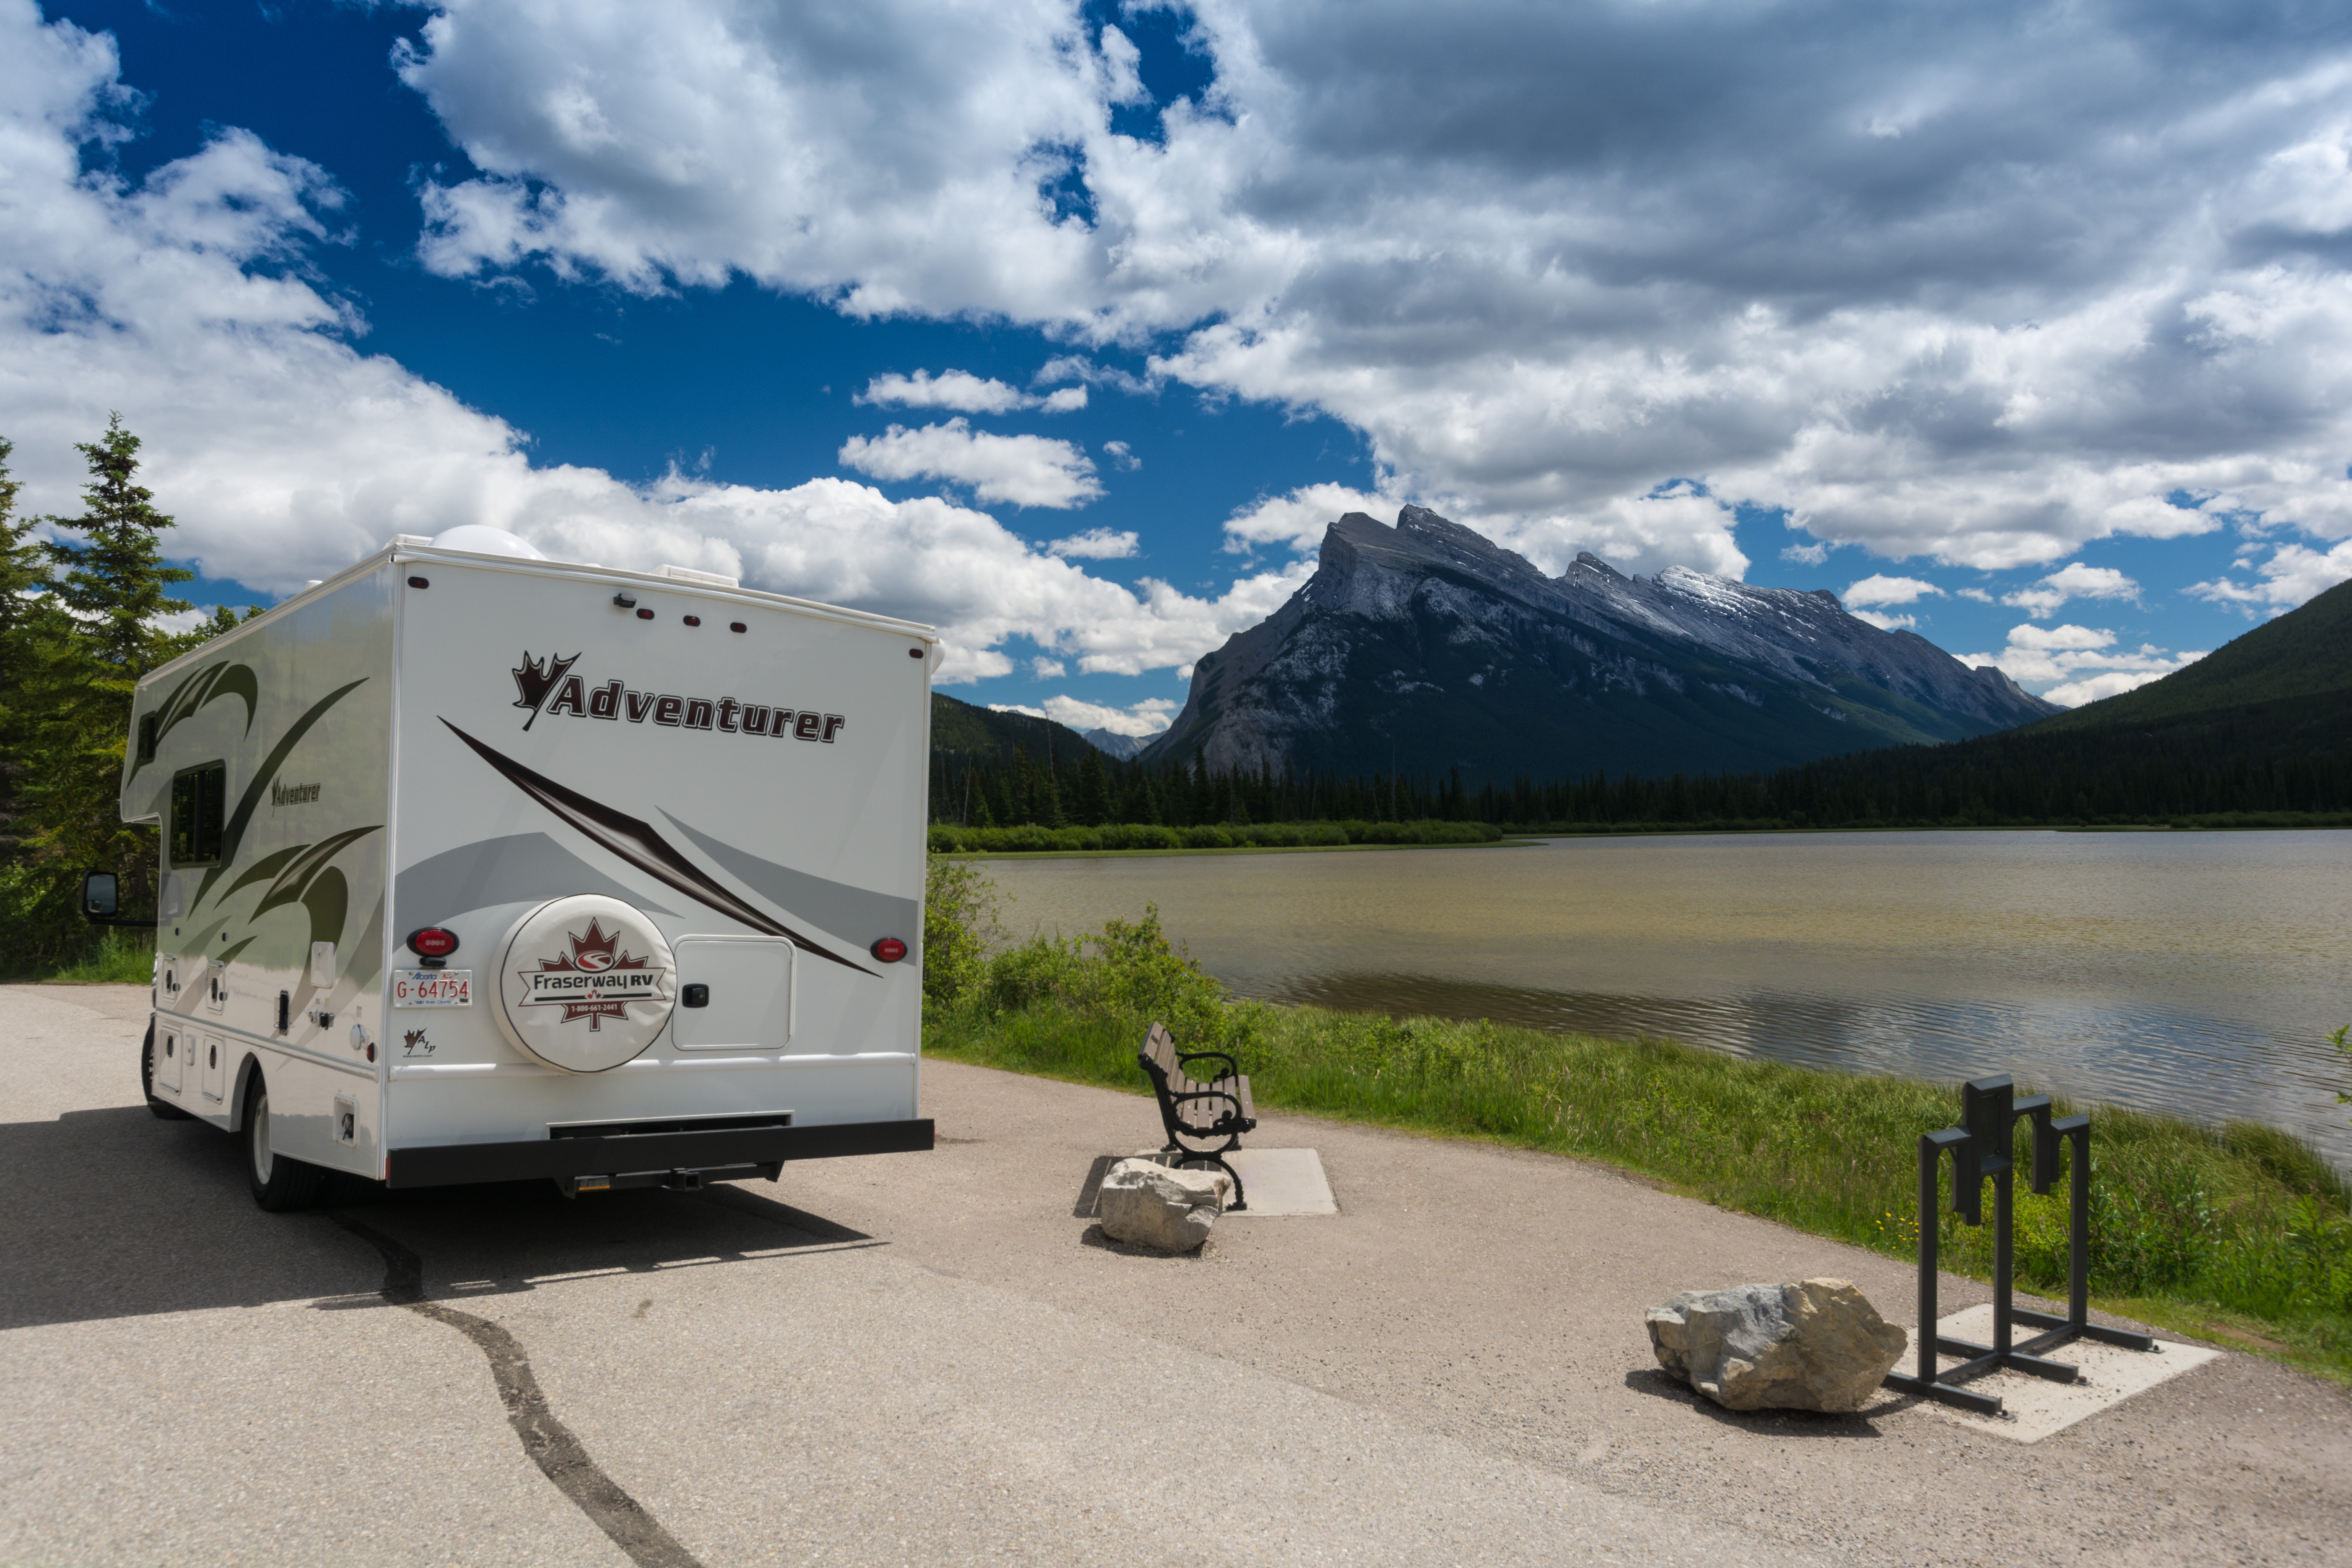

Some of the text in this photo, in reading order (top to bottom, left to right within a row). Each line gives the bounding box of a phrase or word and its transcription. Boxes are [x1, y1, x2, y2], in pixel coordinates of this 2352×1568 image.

[546, 674, 844, 743] Adventurer
[275, 782, 321, 807] Adventurer
[397, 980, 469, 999] G-64754
[534, 974, 654, 990] Fraserway RV
